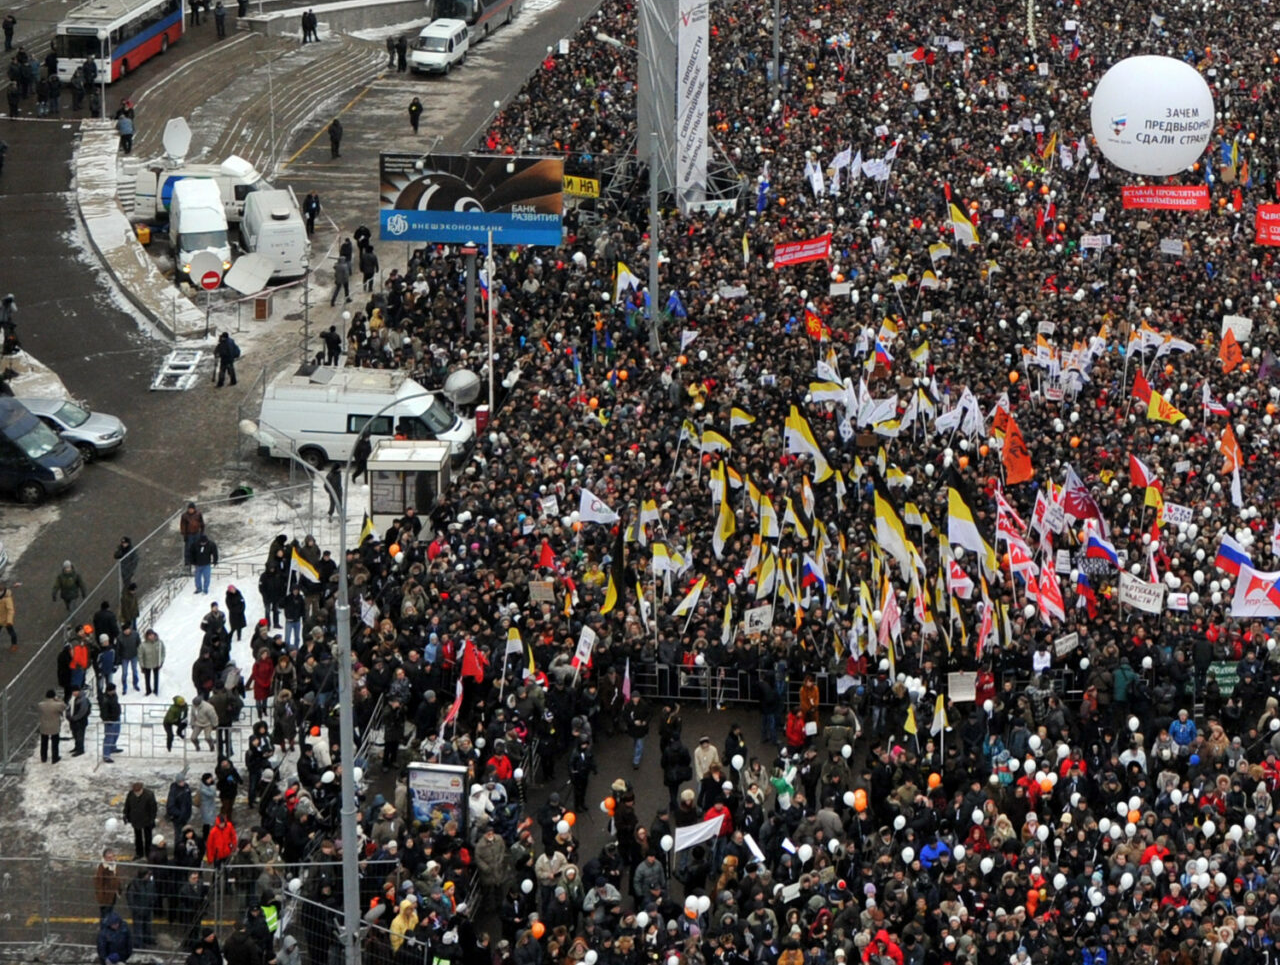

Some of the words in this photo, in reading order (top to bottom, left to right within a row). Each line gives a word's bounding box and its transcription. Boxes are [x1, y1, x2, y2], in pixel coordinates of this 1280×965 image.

[1166, 107, 1199, 118] ЗАЧЕМ
[1136, 132, 1175, 145] СДАЛИ
[511, 204, 537, 213] БАНК
[511, 212, 559, 223] РАЗВИТИЯ
[412, 222, 504, 232] ВНЕШЭКОНОМБАНК
